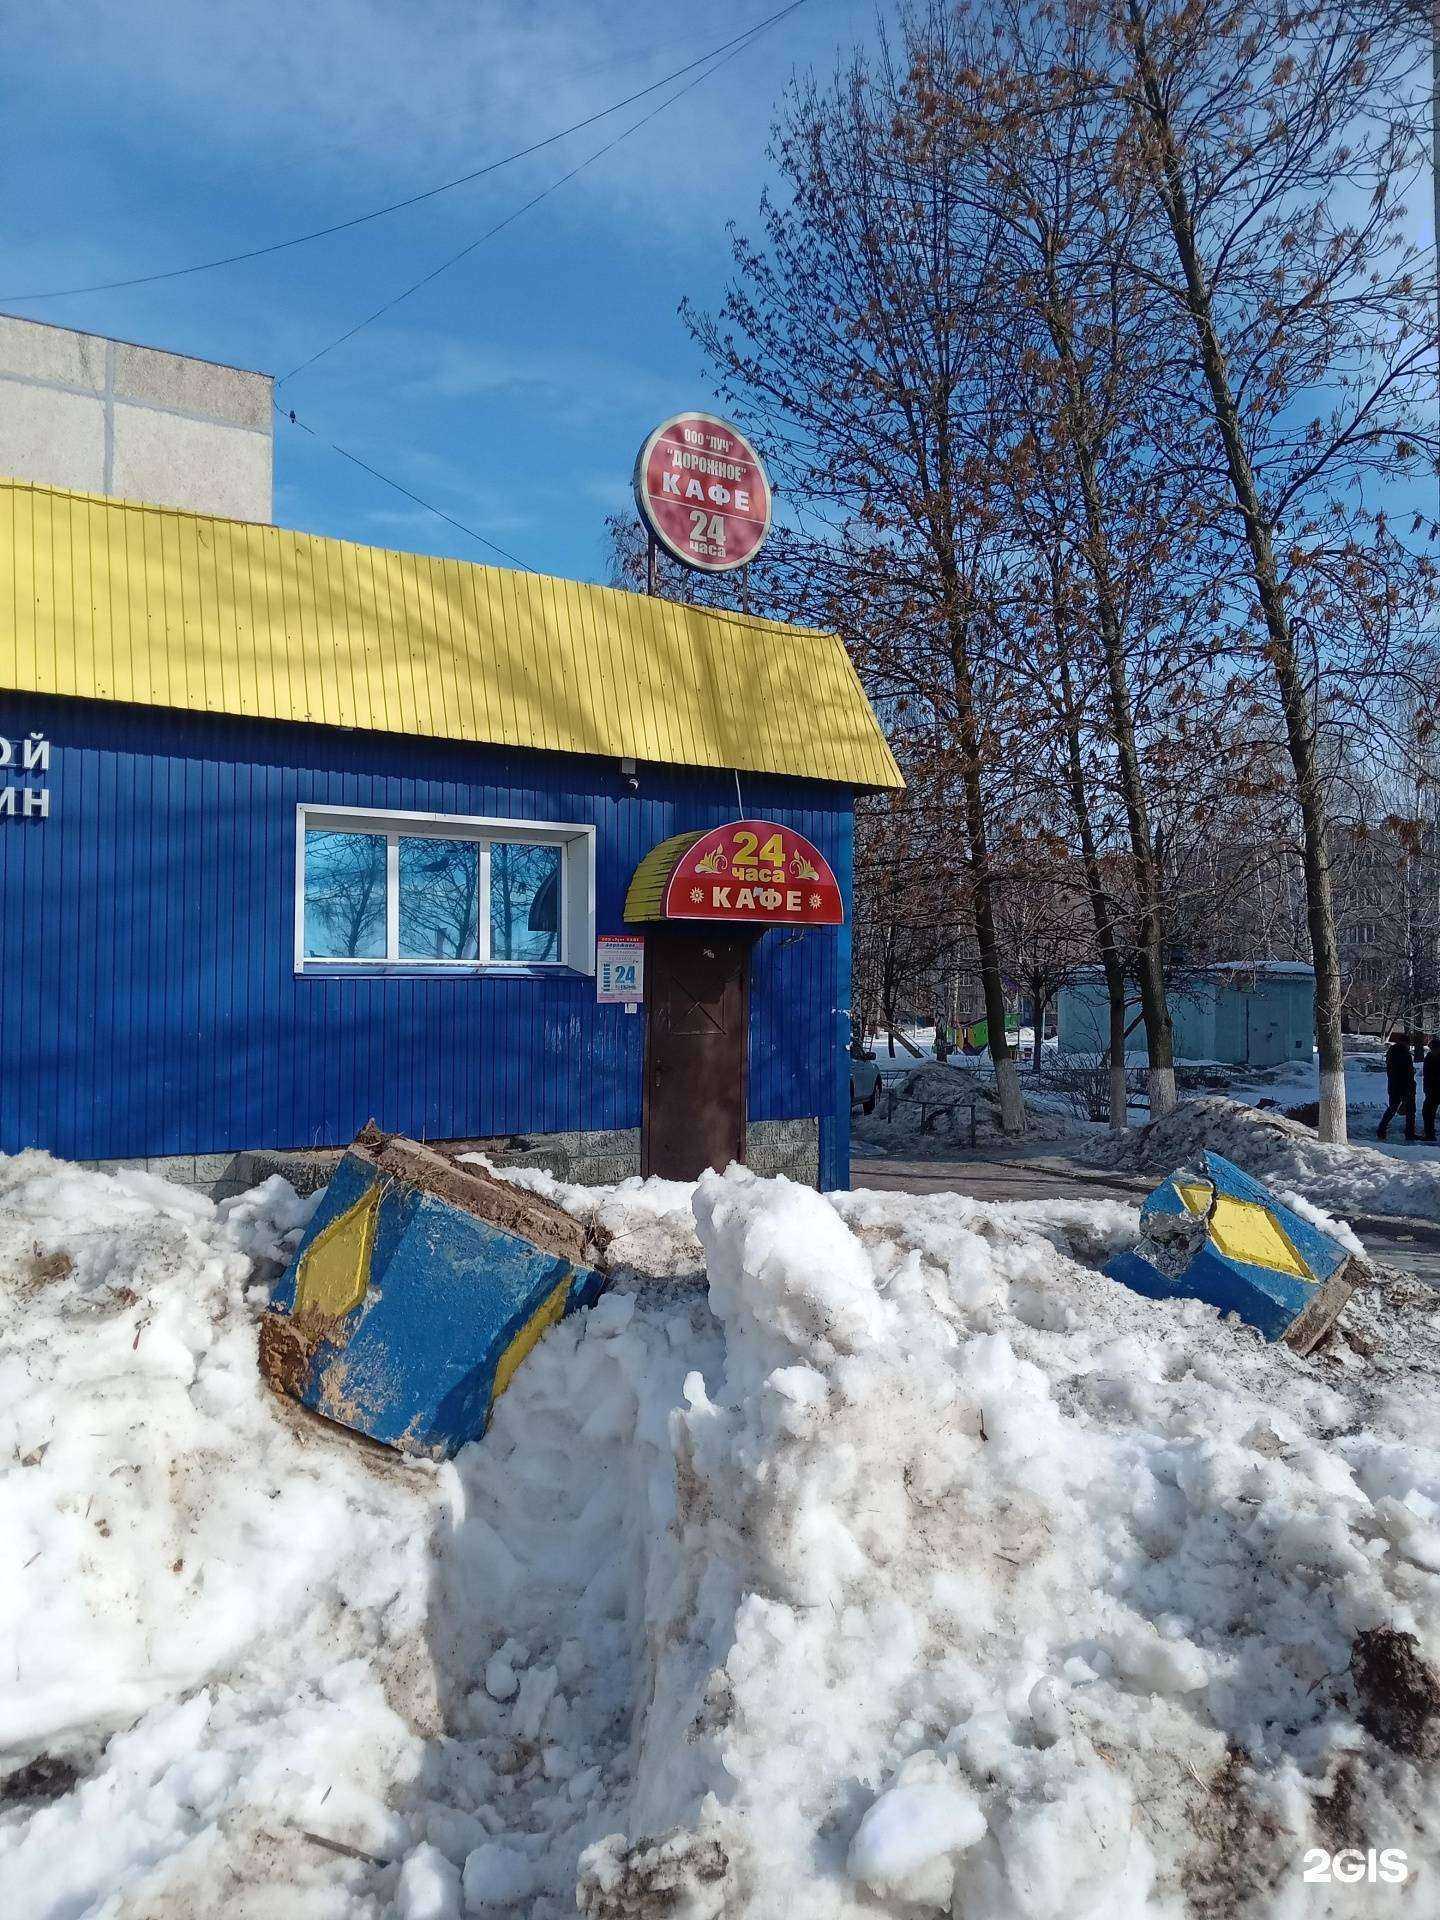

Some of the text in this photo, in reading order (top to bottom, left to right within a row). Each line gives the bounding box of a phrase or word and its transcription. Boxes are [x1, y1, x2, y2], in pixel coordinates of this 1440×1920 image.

[684, 429, 704, 446] ООО
[662, 472, 750, 512] КАФЕ
[689, 511, 727, 546] 24
[690, 541, 727, 558] часа
[731, 832, 786, 867] 24
[731, 867, 786, 884] часа
[712, 886, 802, 912] КАФЕ
[615, 965, 636, 984] 24
